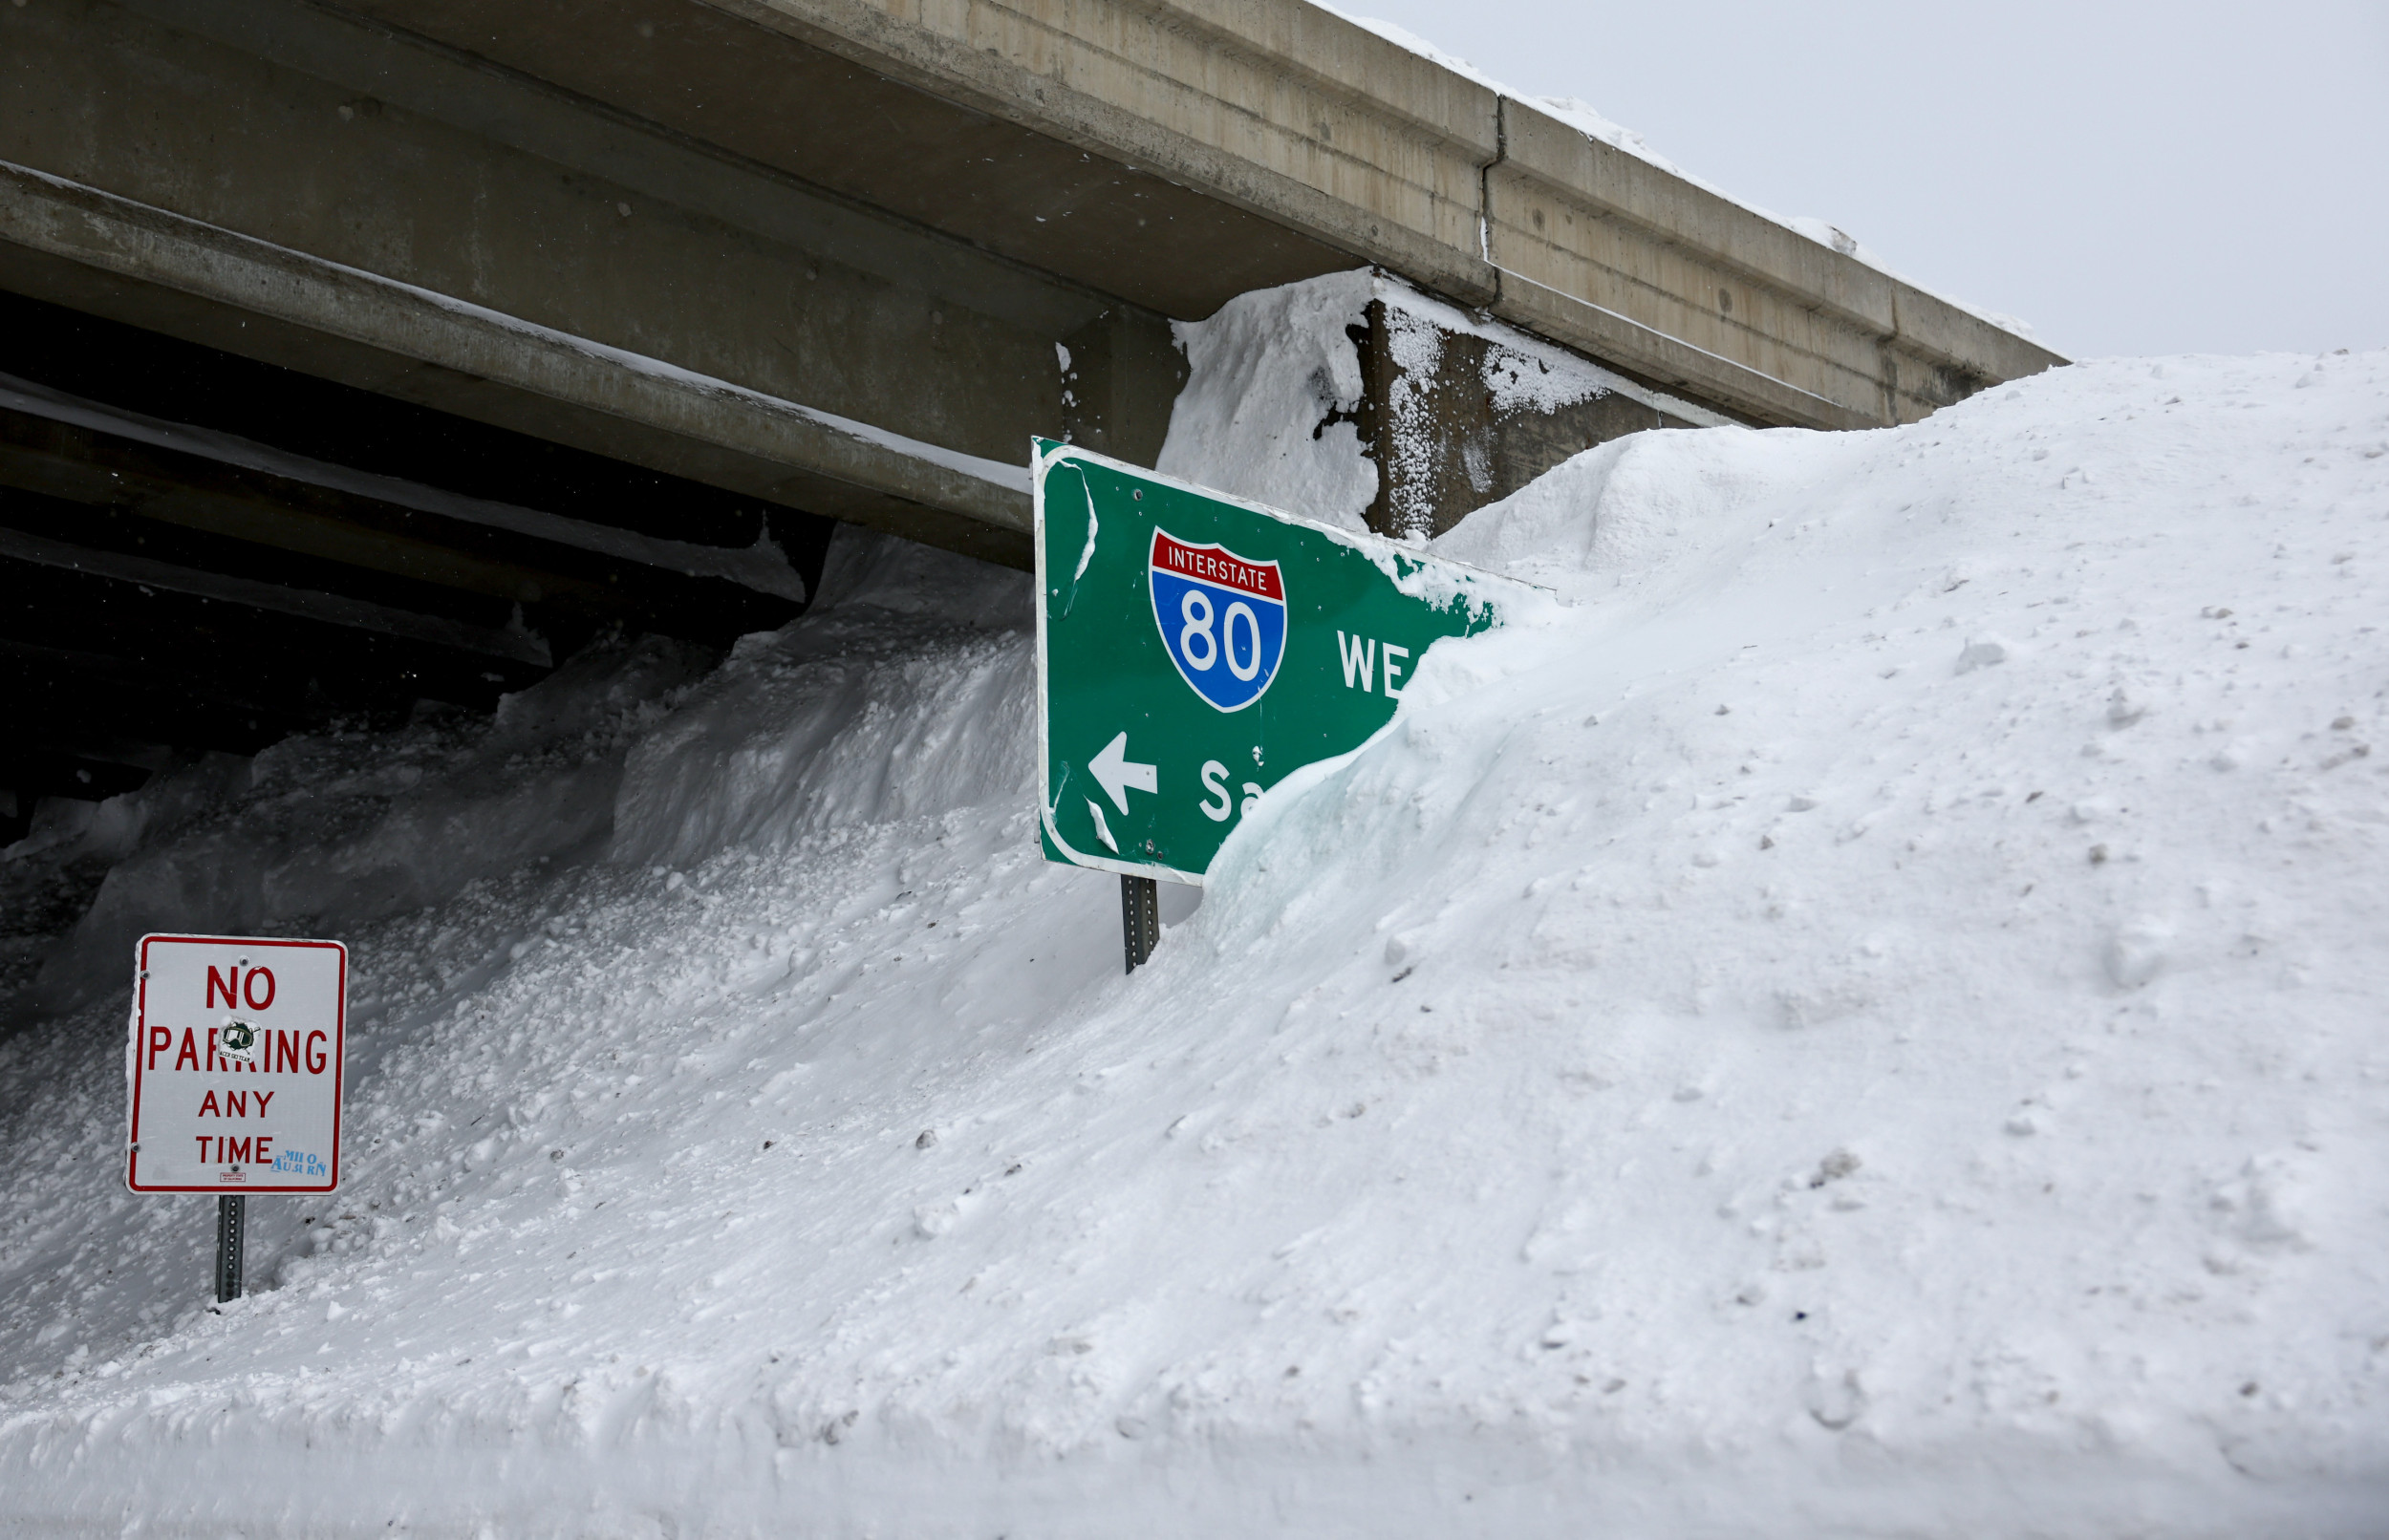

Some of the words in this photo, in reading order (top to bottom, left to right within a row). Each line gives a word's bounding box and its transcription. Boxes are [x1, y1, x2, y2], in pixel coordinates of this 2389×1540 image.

[1169, 545, 1267, 590] INTERSTATE
[1179, 588, 1261, 682] 80
[1337, 630, 1410, 700] WE
[207, 966, 275, 1010] NO
[149, 1026, 327, 1074] PARING
[199, 1090, 273, 1117] ANY
[197, 1137, 272, 1163] TIME
